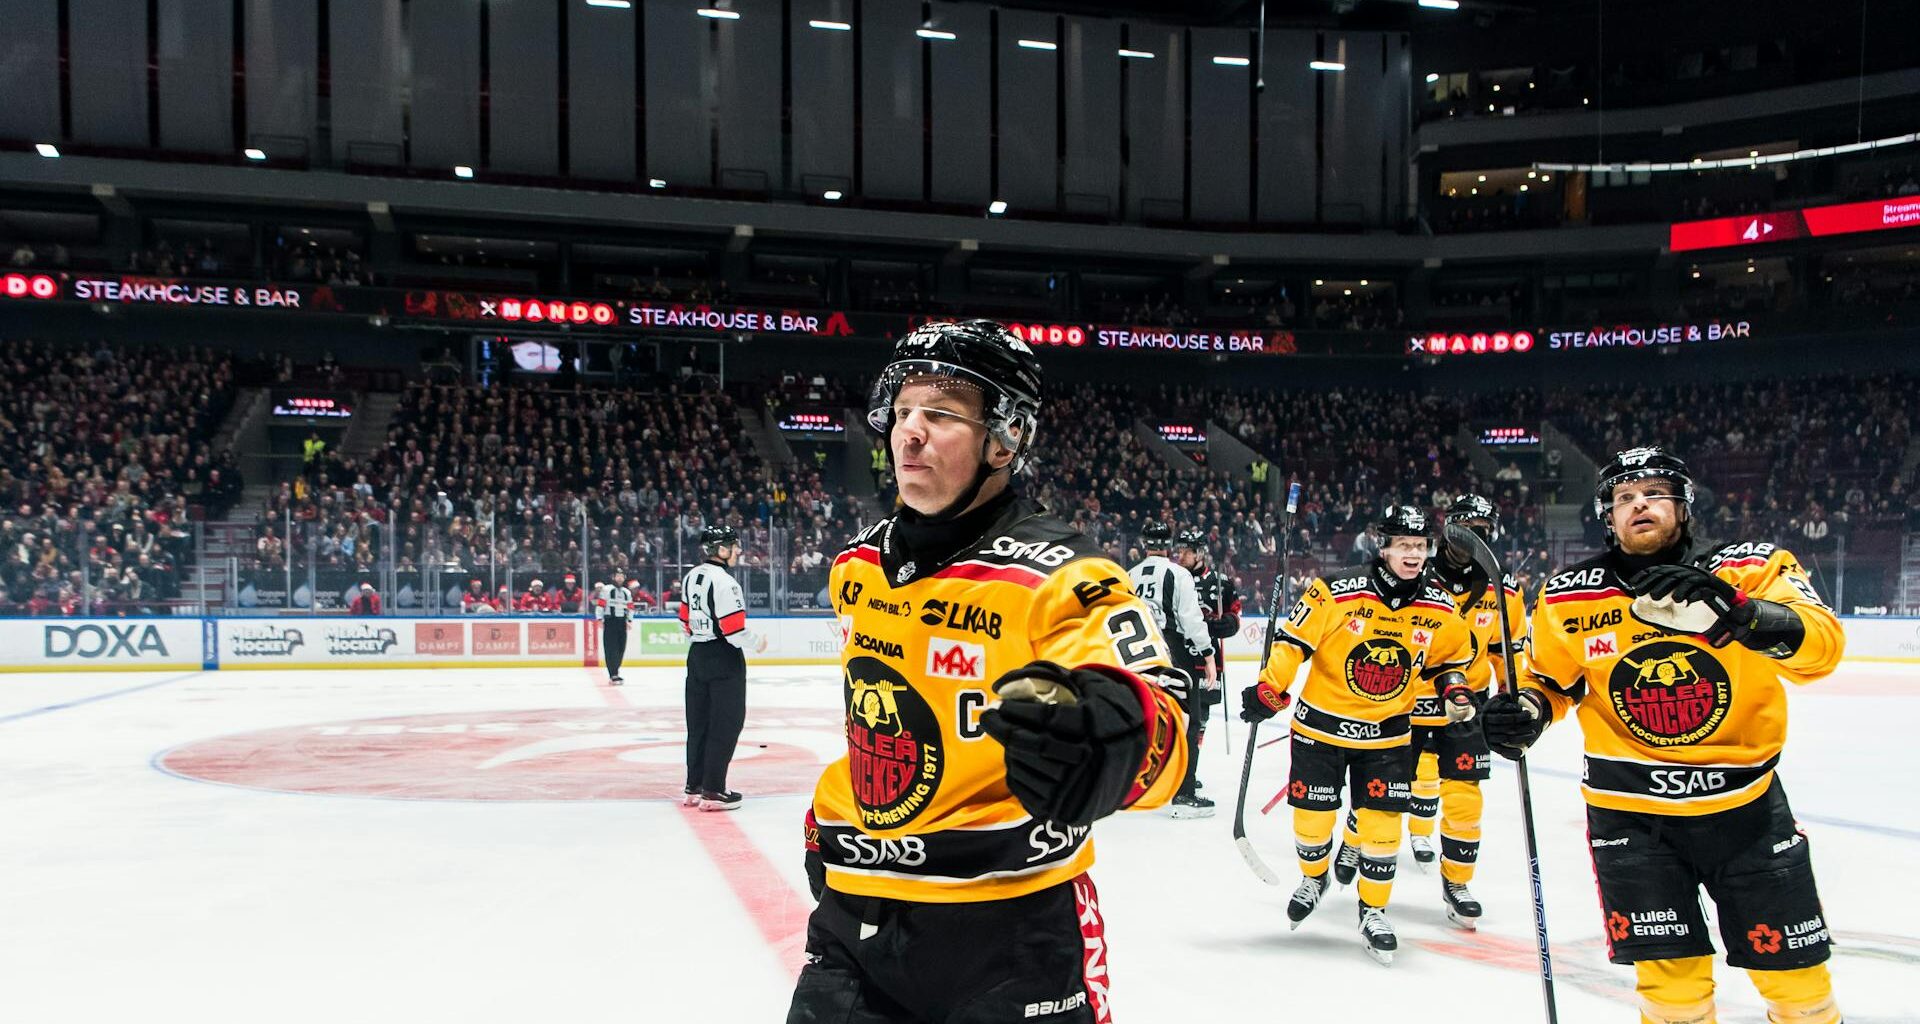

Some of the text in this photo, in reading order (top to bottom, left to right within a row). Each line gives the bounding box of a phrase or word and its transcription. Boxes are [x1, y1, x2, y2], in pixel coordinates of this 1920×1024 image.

[75, 279, 229, 306] STEAKHOUSE
[234, 288, 250, 306] &
[255, 288, 300, 308] BAR
[502, 300, 818, 332] MANDO STEAKHOUSE & BAR
[1010, 325, 1264, 352] ANDO STEAKHOUSE & BAR
[1430, 321, 1751, 353] MANDO STEAKHOUSE & BAR
[1330, 576, 1368, 594] SSAB
[1502, 573, 1518, 588] AB
[1545, 568, 1605, 592] SSAB
[947, 602, 1003, 640] LKAB
[1581, 608, 1623, 632] LKAB
[44, 623, 169, 659] DOXA
[854, 632, 905, 660] SCANIA
[1588, 638, 1615, 658] MAX
[931, 644, 979, 678] MAX
[1625, 678, 1714, 703] LULEÅ
[958, 692, 985, 739] C
[1413, 700, 1441, 715] SSA
[1612, 691, 1633, 723] LULEÅ
[1629, 707, 1725, 746] HOCKEYFÖRENING
[1627, 697, 1714, 735] HOCKEY
[1337, 721, 1382, 739] SSAB
[922, 743, 938, 780] 1977
[850, 744, 917, 806] OCKEY
[1649, 769, 1727, 795] SSAB
[1308, 784, 1335, 794] Luleå
[1388, 789, 1412, 800] Energ
[837, 833, 927, 867] SSAB
[1631, 908, 1678, 924] Luleå
[1784, 914, 1822, 937] Luleå
[1633, 922, 1689, 937] Energi
